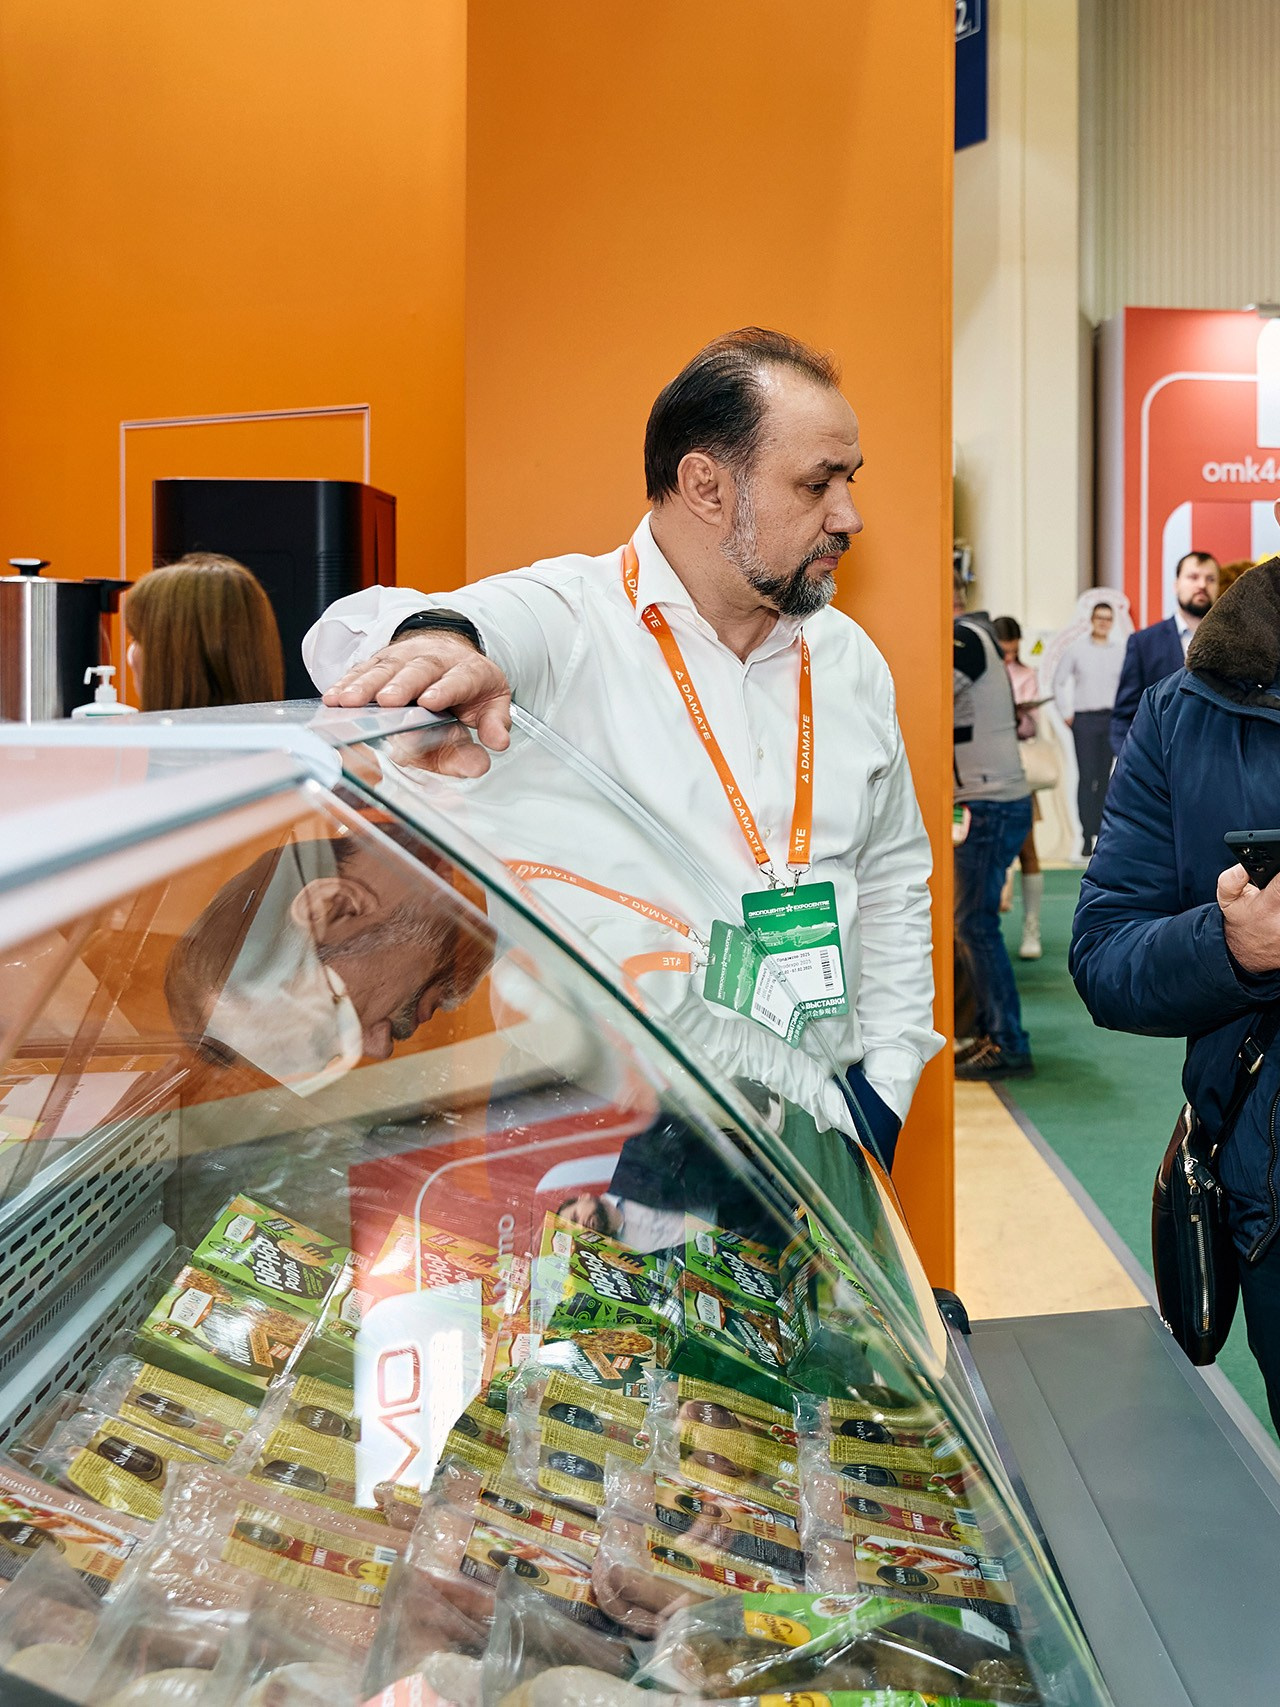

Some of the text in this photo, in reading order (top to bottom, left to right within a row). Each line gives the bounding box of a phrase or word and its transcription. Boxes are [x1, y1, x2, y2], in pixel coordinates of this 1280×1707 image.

[681, 683, 712, 740] DAMATE
[801, 714, 810, 769] DAMATE
[733, 798, 763, 853] DAMATE
[805, 996, 845, 1010] ВЫСТАВКИ
